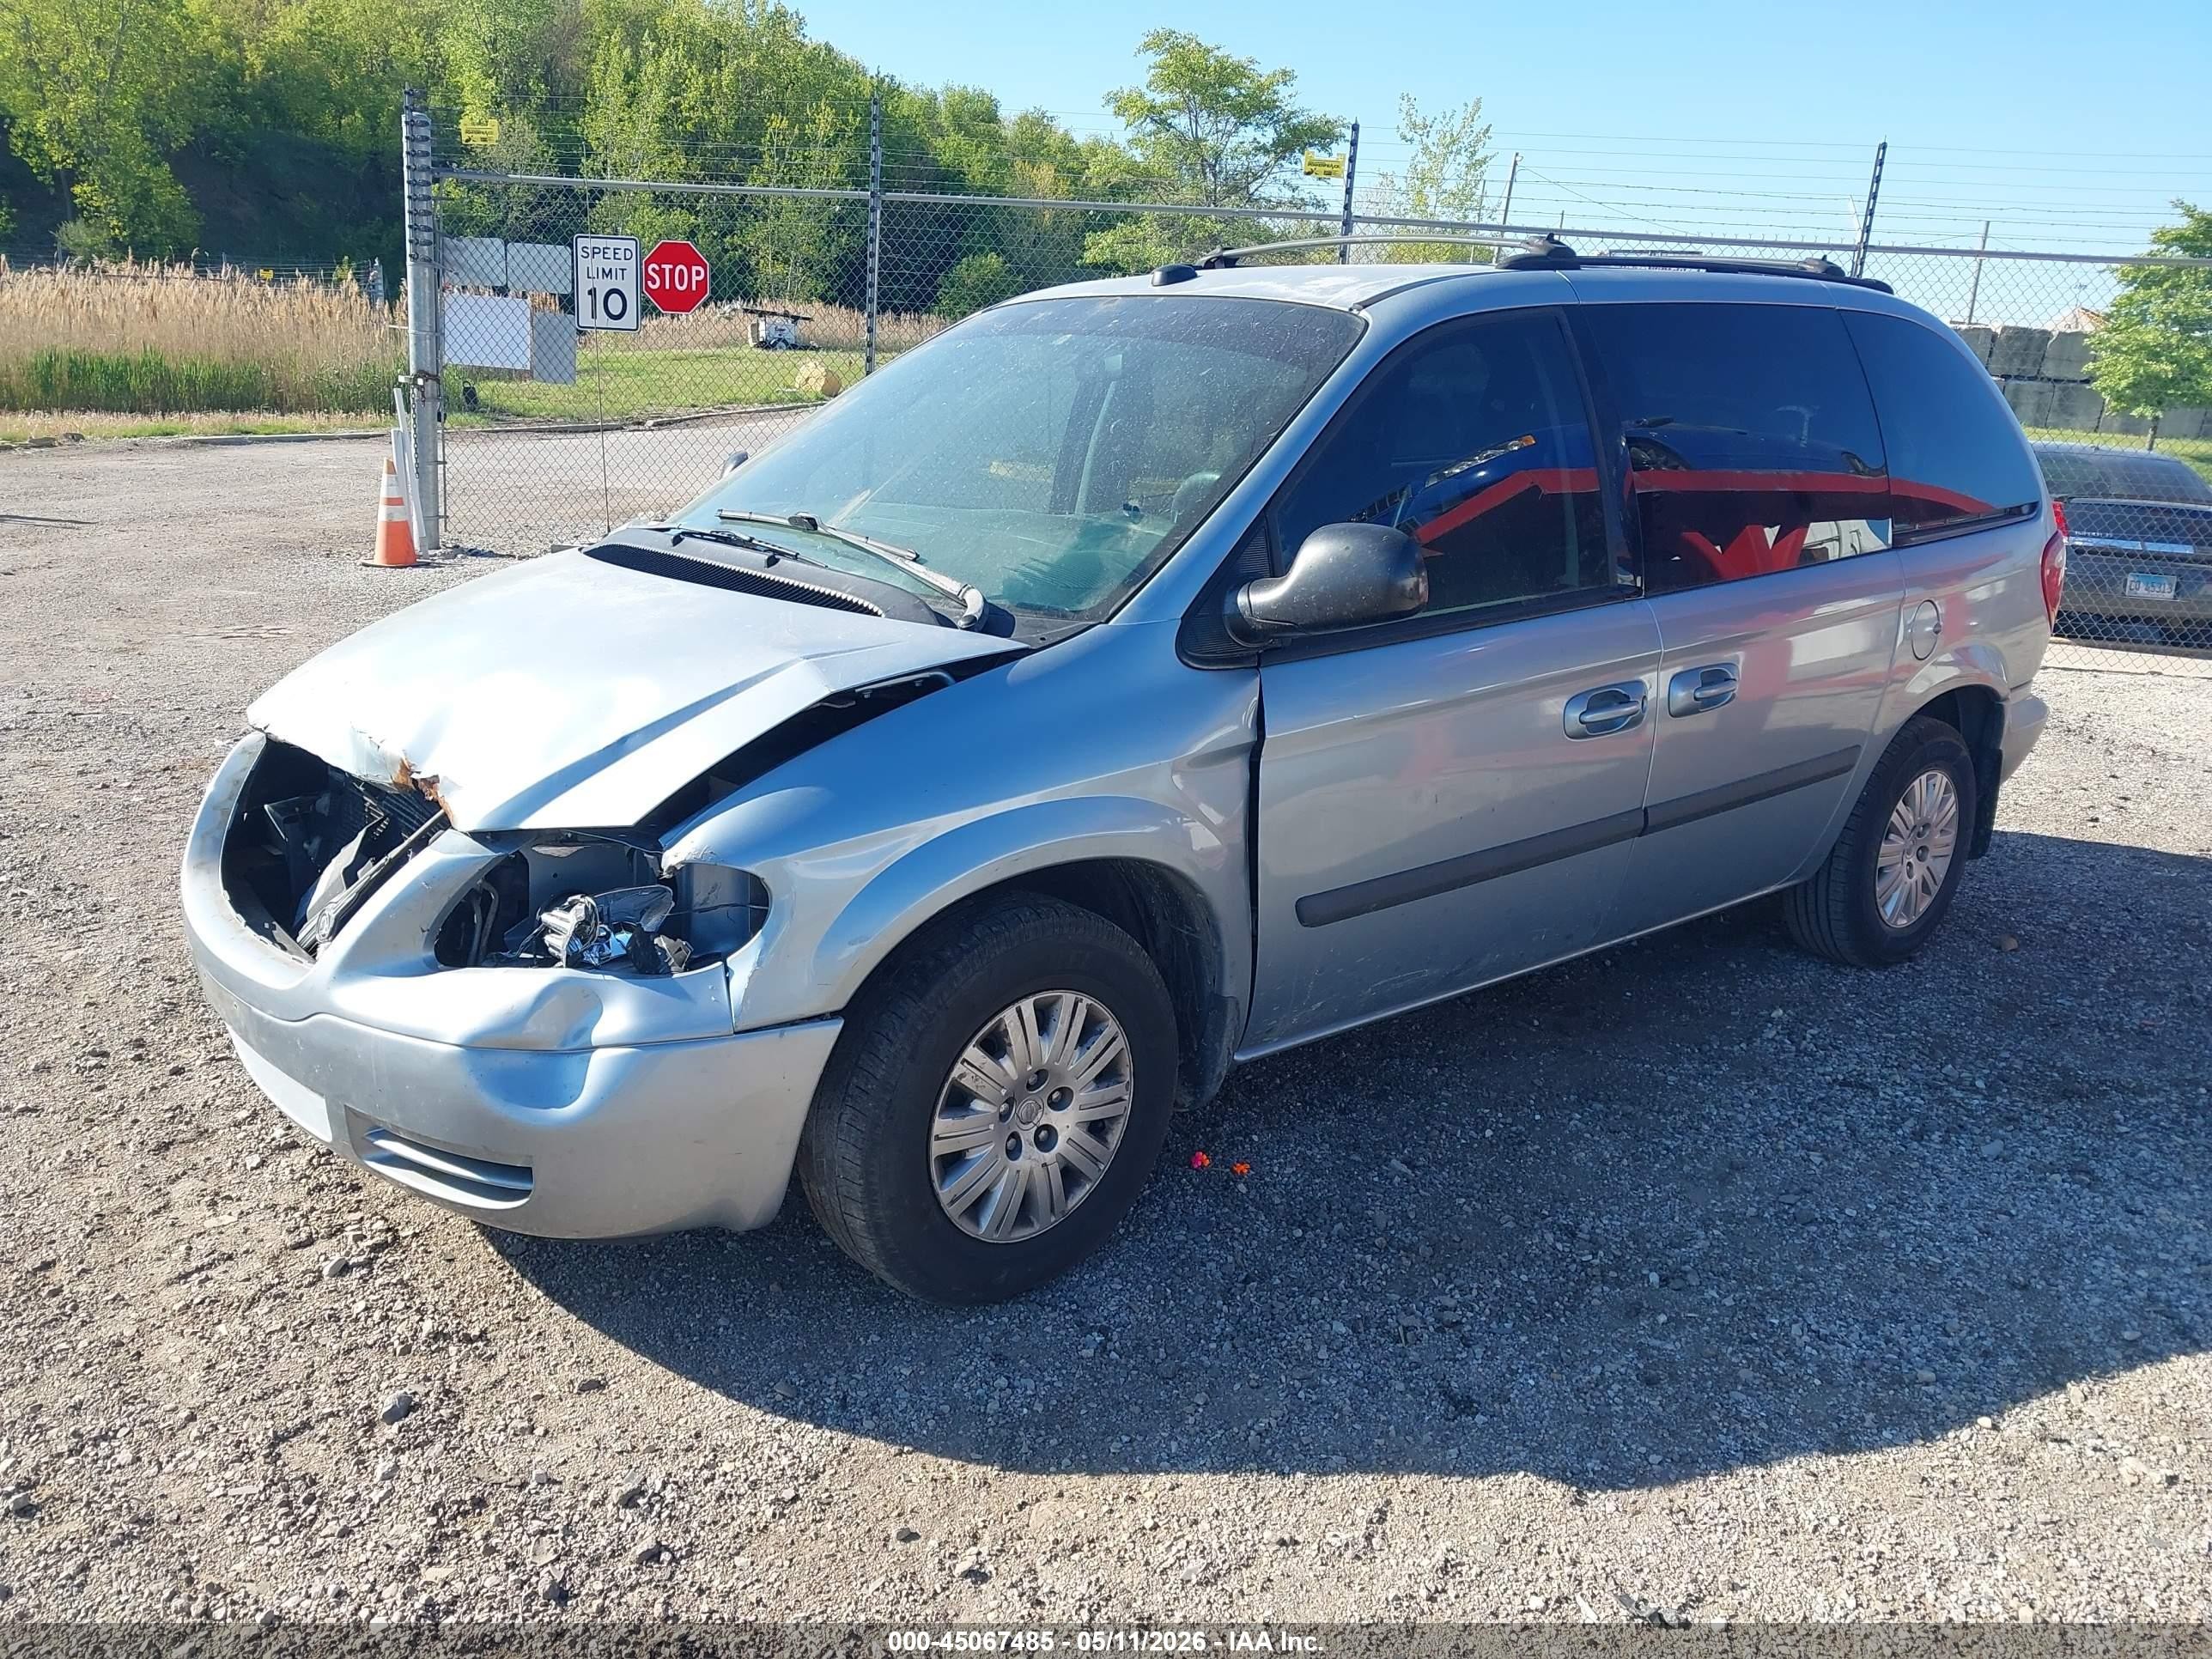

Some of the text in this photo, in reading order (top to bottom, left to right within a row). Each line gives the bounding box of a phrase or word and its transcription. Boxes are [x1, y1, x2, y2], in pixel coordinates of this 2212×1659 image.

[580, 246, 634, 261] SPEED
[586, 266, 628, 281] LIMIT
[647, 263, 705, 291] STOP
[587, 287, 628, 321] 10
